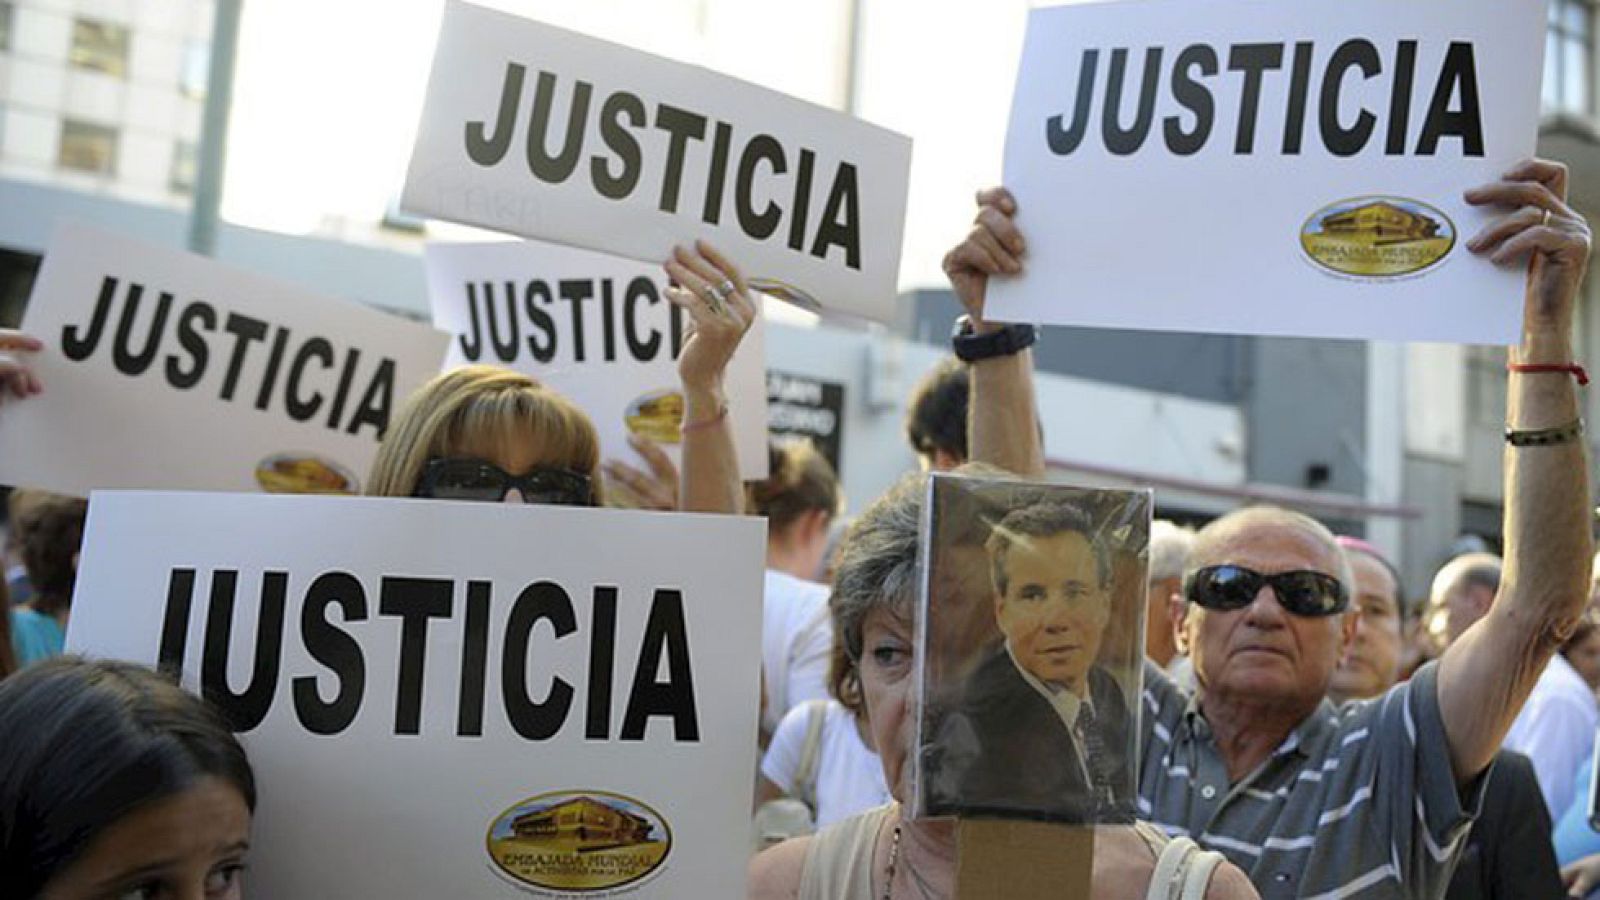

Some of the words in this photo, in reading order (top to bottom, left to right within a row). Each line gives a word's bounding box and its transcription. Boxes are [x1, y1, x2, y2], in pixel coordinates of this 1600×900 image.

[1046, 38, 1485, 158] JUSTICIA
[464, 62, 862, 272] JUSTICIA
[60, 275, 396, 442] JUSTICIA
[459, 276, 684, 363] JUSTICI
[502, 852, 585, 867] EMBAJADA
[587, 852, 654, 868] MUNDIAL
